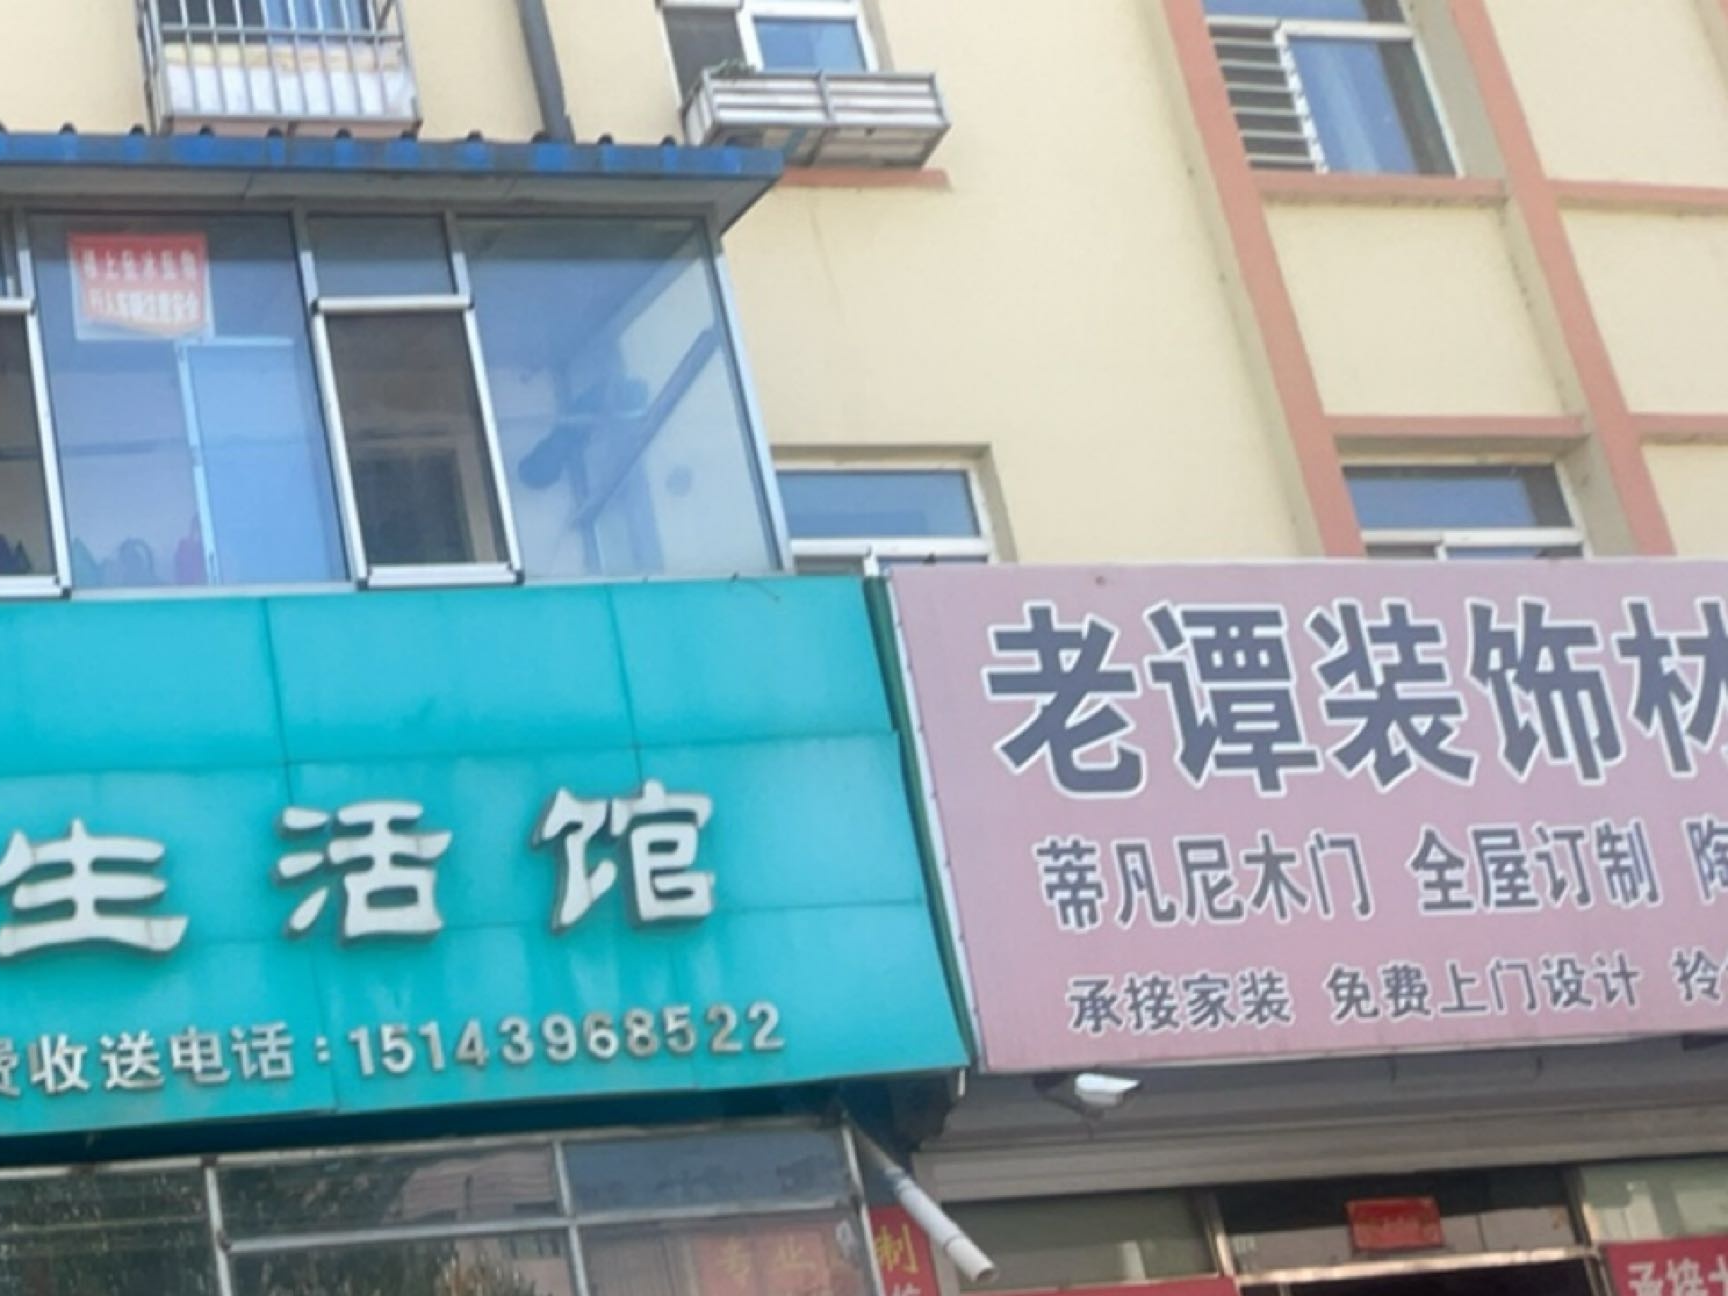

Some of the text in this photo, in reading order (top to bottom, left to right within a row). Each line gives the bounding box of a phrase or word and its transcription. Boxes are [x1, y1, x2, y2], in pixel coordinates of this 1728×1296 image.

[982, 597, 1728, 797] 老谭装饰材
[1035, 832, 1373, 930] 蒂凡尼木门
[1411, 817, 1661, 914] 全屋订制
[1067, 946, 1728, 1033] 承接家装 免费上门设计 拎
